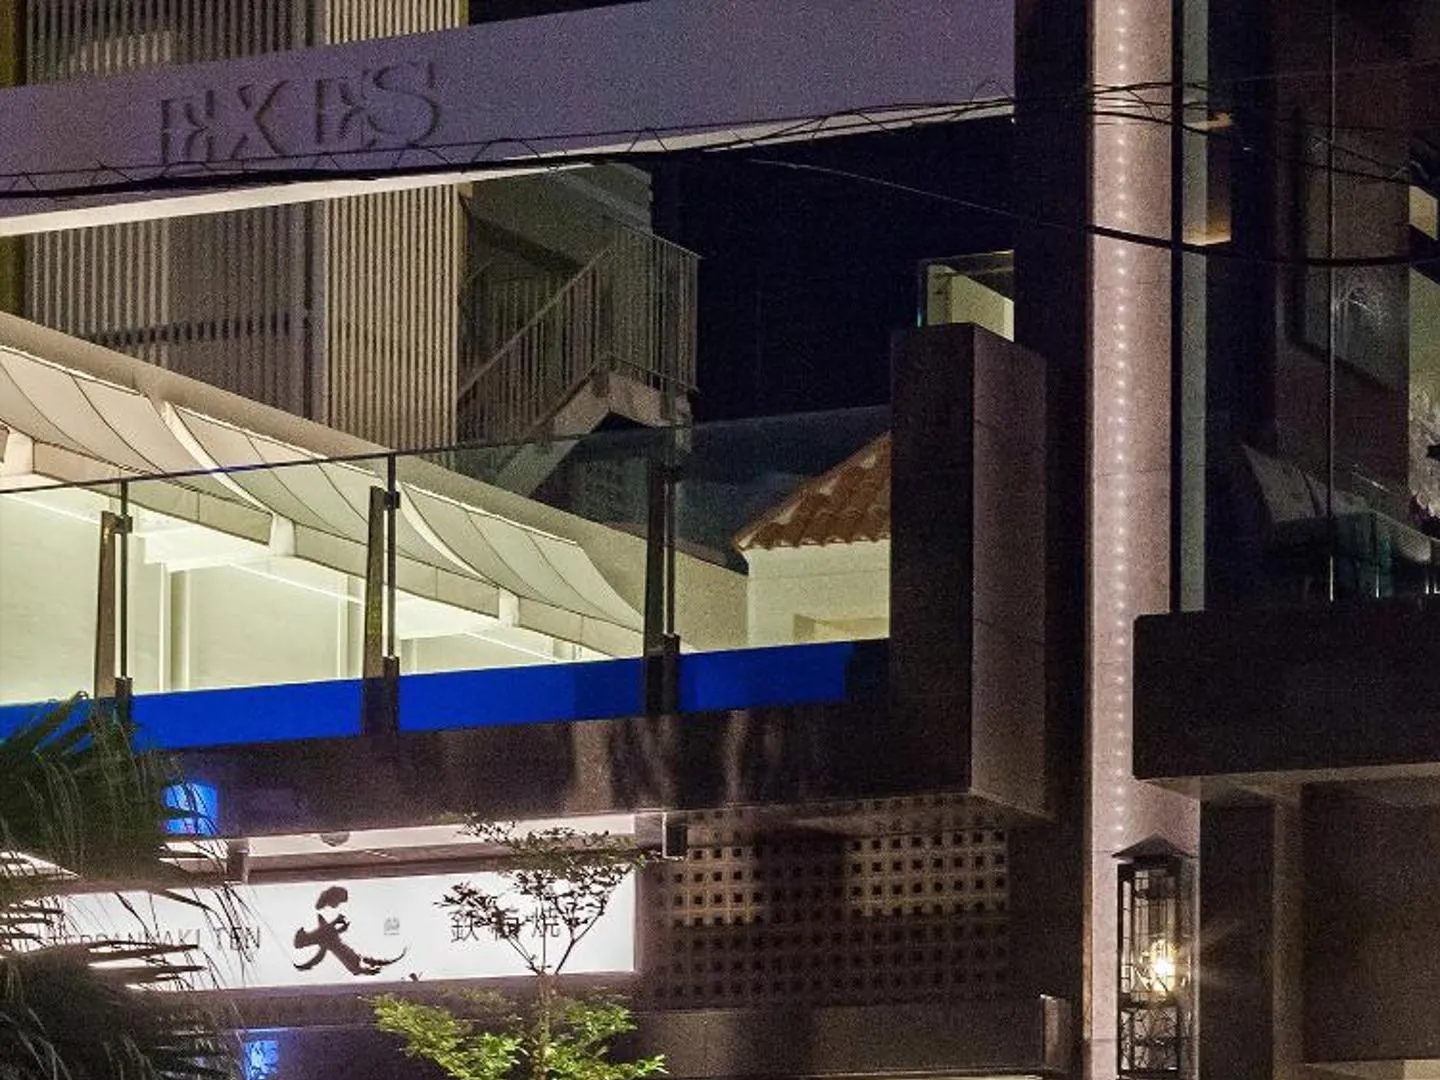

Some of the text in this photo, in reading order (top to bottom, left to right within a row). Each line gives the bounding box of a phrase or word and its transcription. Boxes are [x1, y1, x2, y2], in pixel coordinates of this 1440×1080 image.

[156, 61, 442, 165] EXES
[215, 925, 261, 951] TEN
[294, 885, 408, 976] 天
